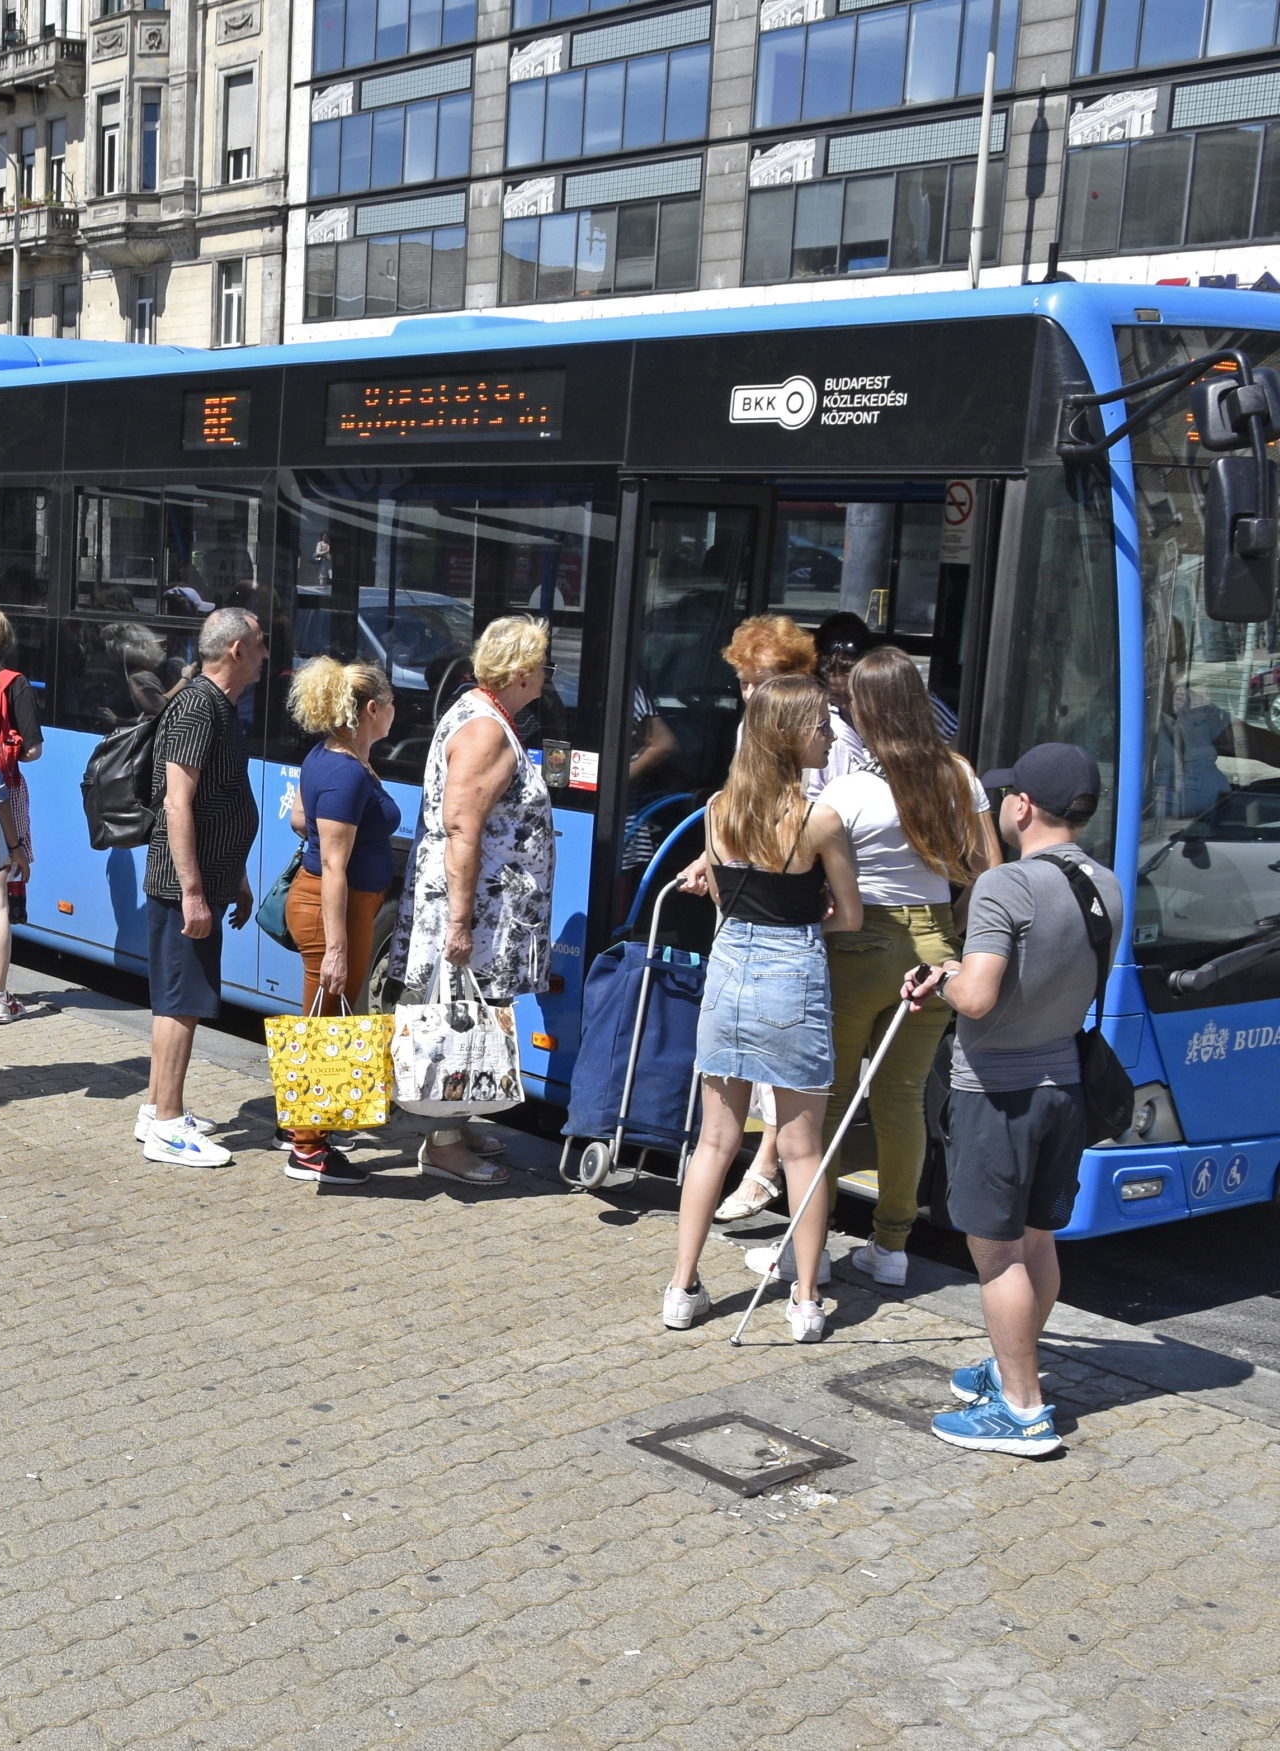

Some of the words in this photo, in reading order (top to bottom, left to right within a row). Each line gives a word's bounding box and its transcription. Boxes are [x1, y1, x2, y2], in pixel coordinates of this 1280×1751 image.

[824, 375, 891, 391] BUDAPEST
[742, 396, 777, 411] BKK
[822, 390, 908, 408] KÖZLEKEDÉSI
[820, 409, 880, 425] KÖZPONT
[280, 766, 287, 777] A
[1022, 1421, 1050, 1437] HOKA
